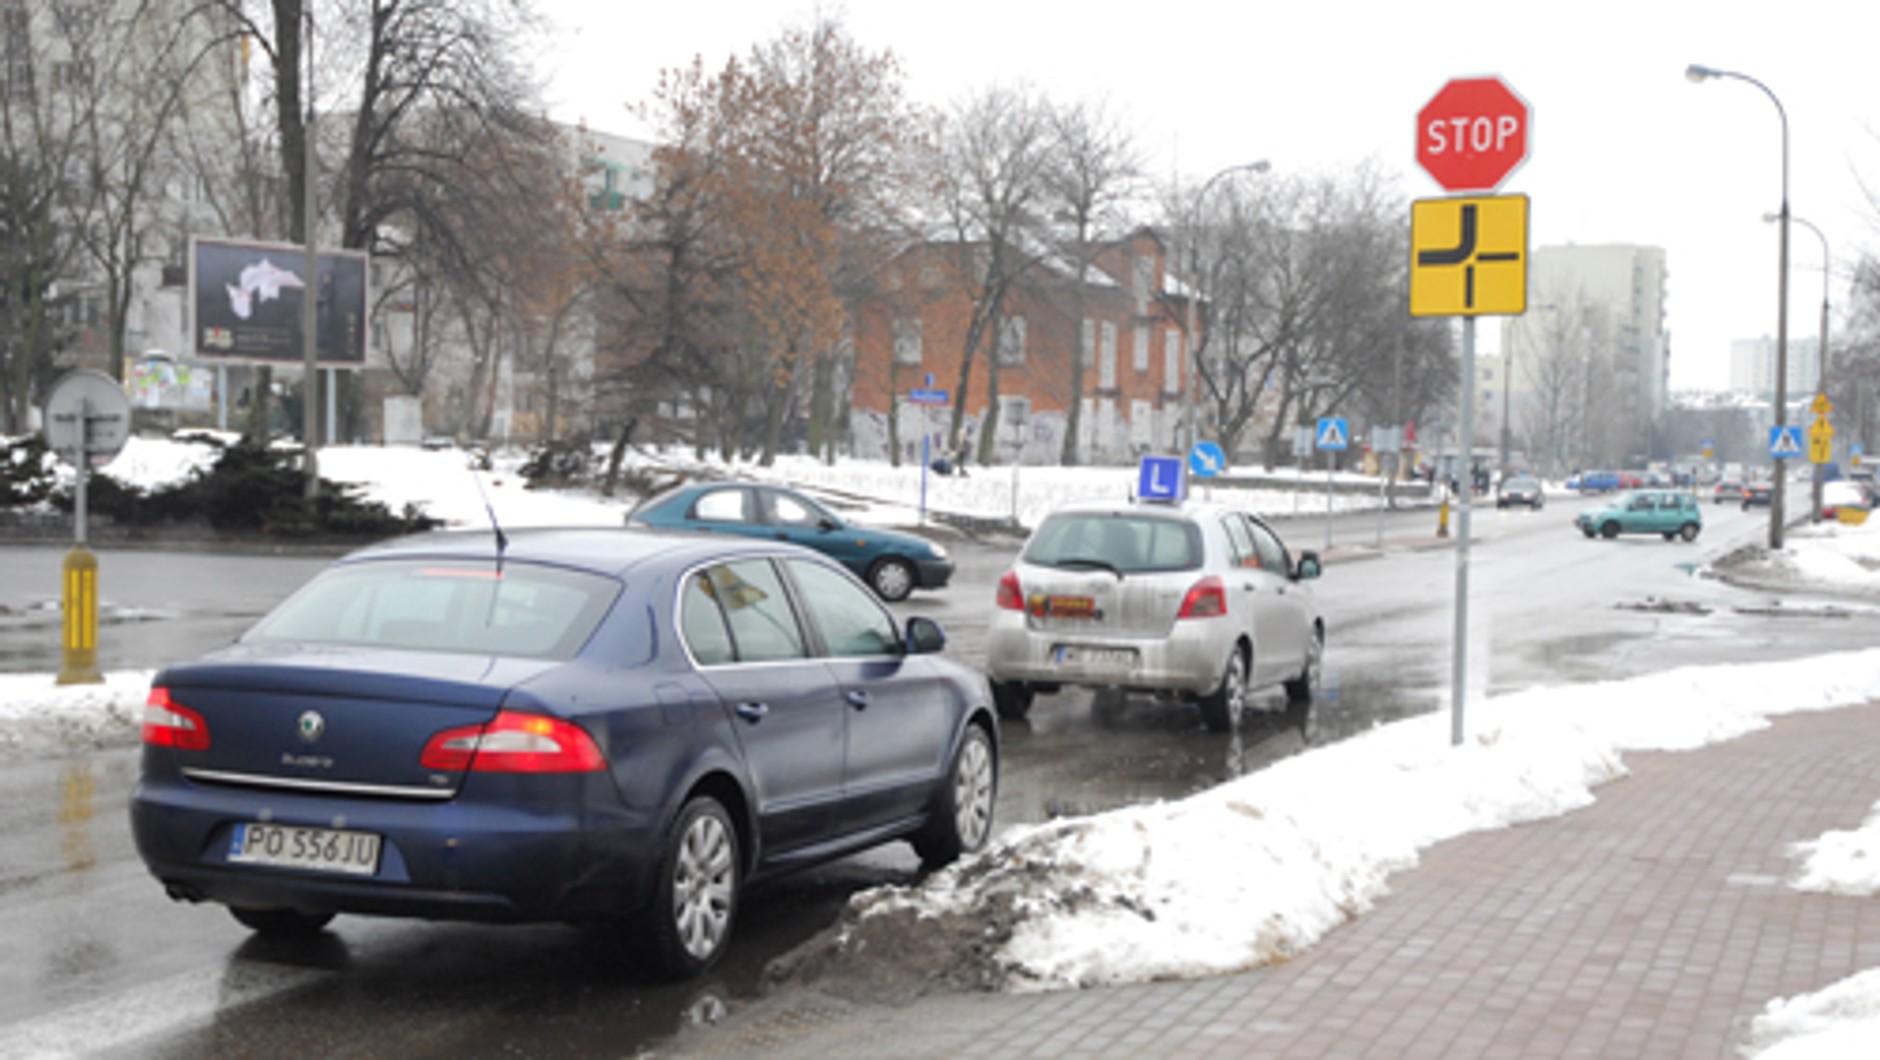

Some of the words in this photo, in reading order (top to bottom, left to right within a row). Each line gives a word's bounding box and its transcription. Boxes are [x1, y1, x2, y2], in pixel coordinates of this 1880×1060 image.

[1427, 115, 1518, 154] STOP
[1150, 462, 1170, 494] L
[247, 826, 284, 857] PO
[291, 830, 375, 866] 556JU
